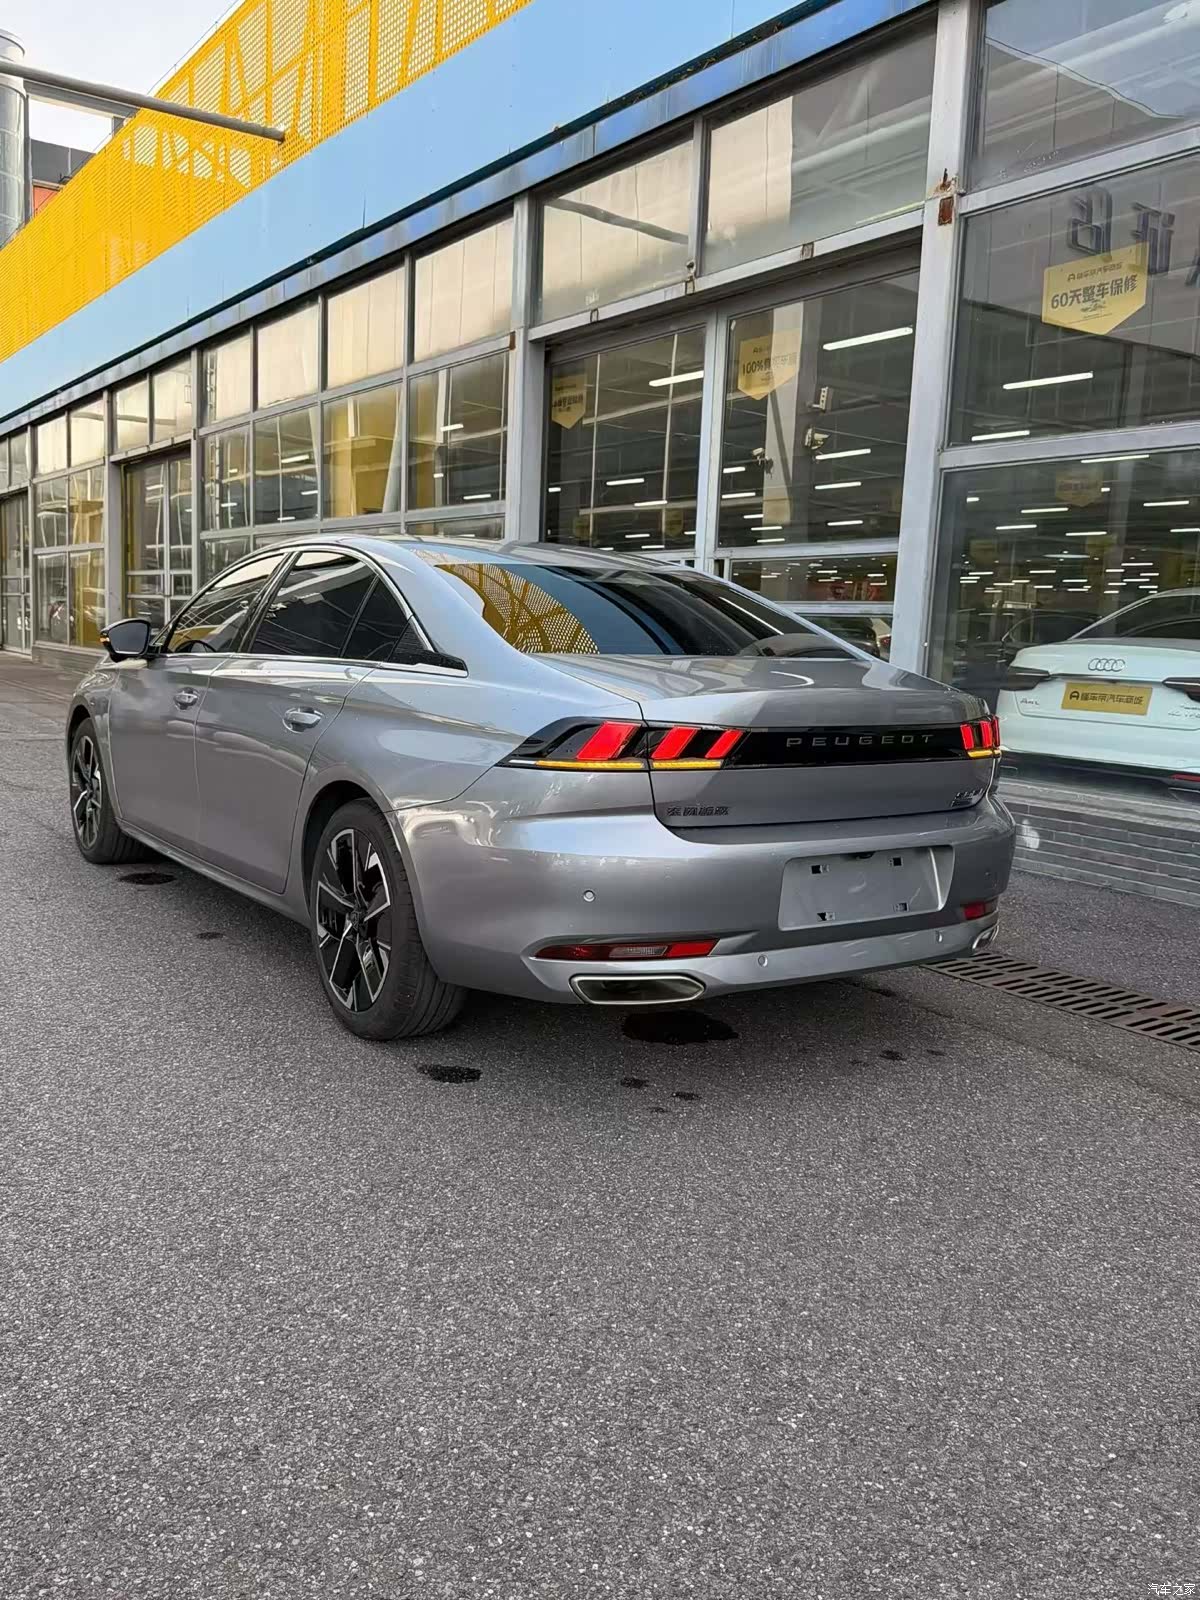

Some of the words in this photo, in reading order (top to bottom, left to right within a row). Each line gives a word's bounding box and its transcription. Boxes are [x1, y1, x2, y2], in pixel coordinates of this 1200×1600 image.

[1051, 274, 1138, 309] 60天整车保修
[786, 734, 934, 747] PEUGEOT
